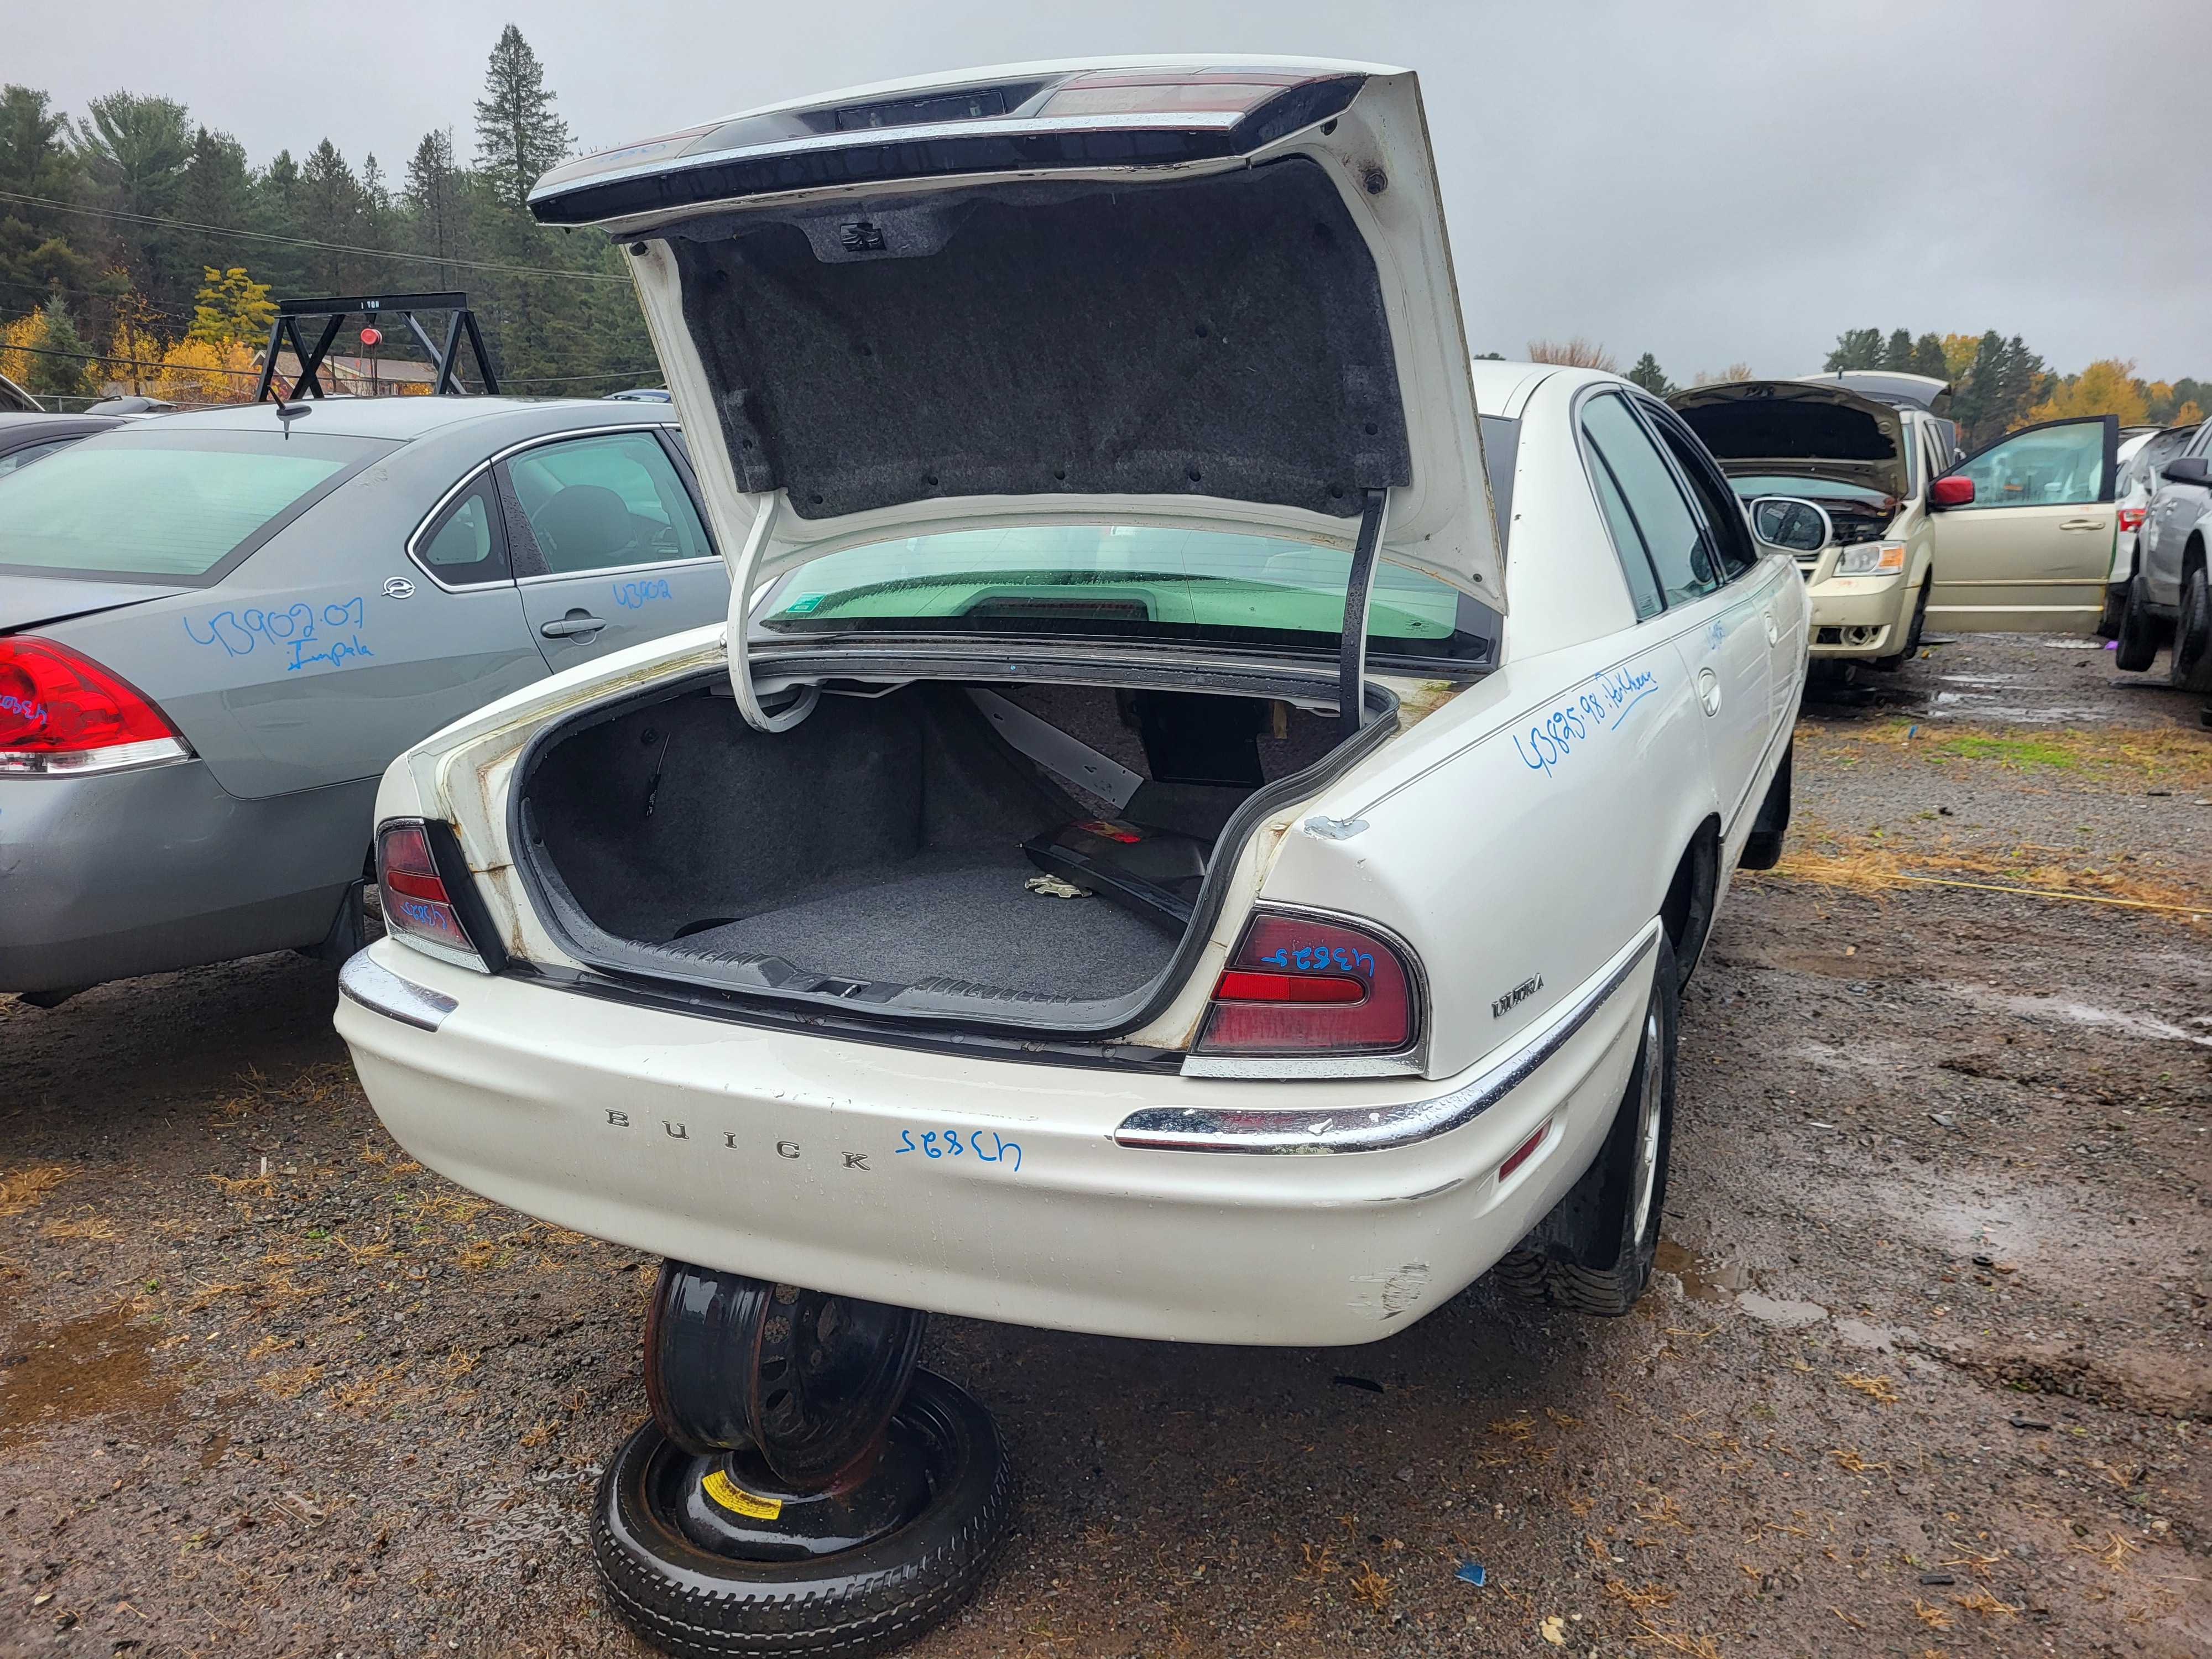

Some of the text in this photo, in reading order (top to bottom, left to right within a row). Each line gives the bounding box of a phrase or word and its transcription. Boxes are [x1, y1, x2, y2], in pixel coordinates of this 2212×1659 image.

[367, 300, 379, 309] TON
[612, 579, 672, 609] 43902
[1261, 947, 1375, 977] 43825
[1491, 972, 1544, 1018] ULTRA
[605, 1108, 872, 1171] BUICK
[895, 1130, 1021, 1172] 43825
